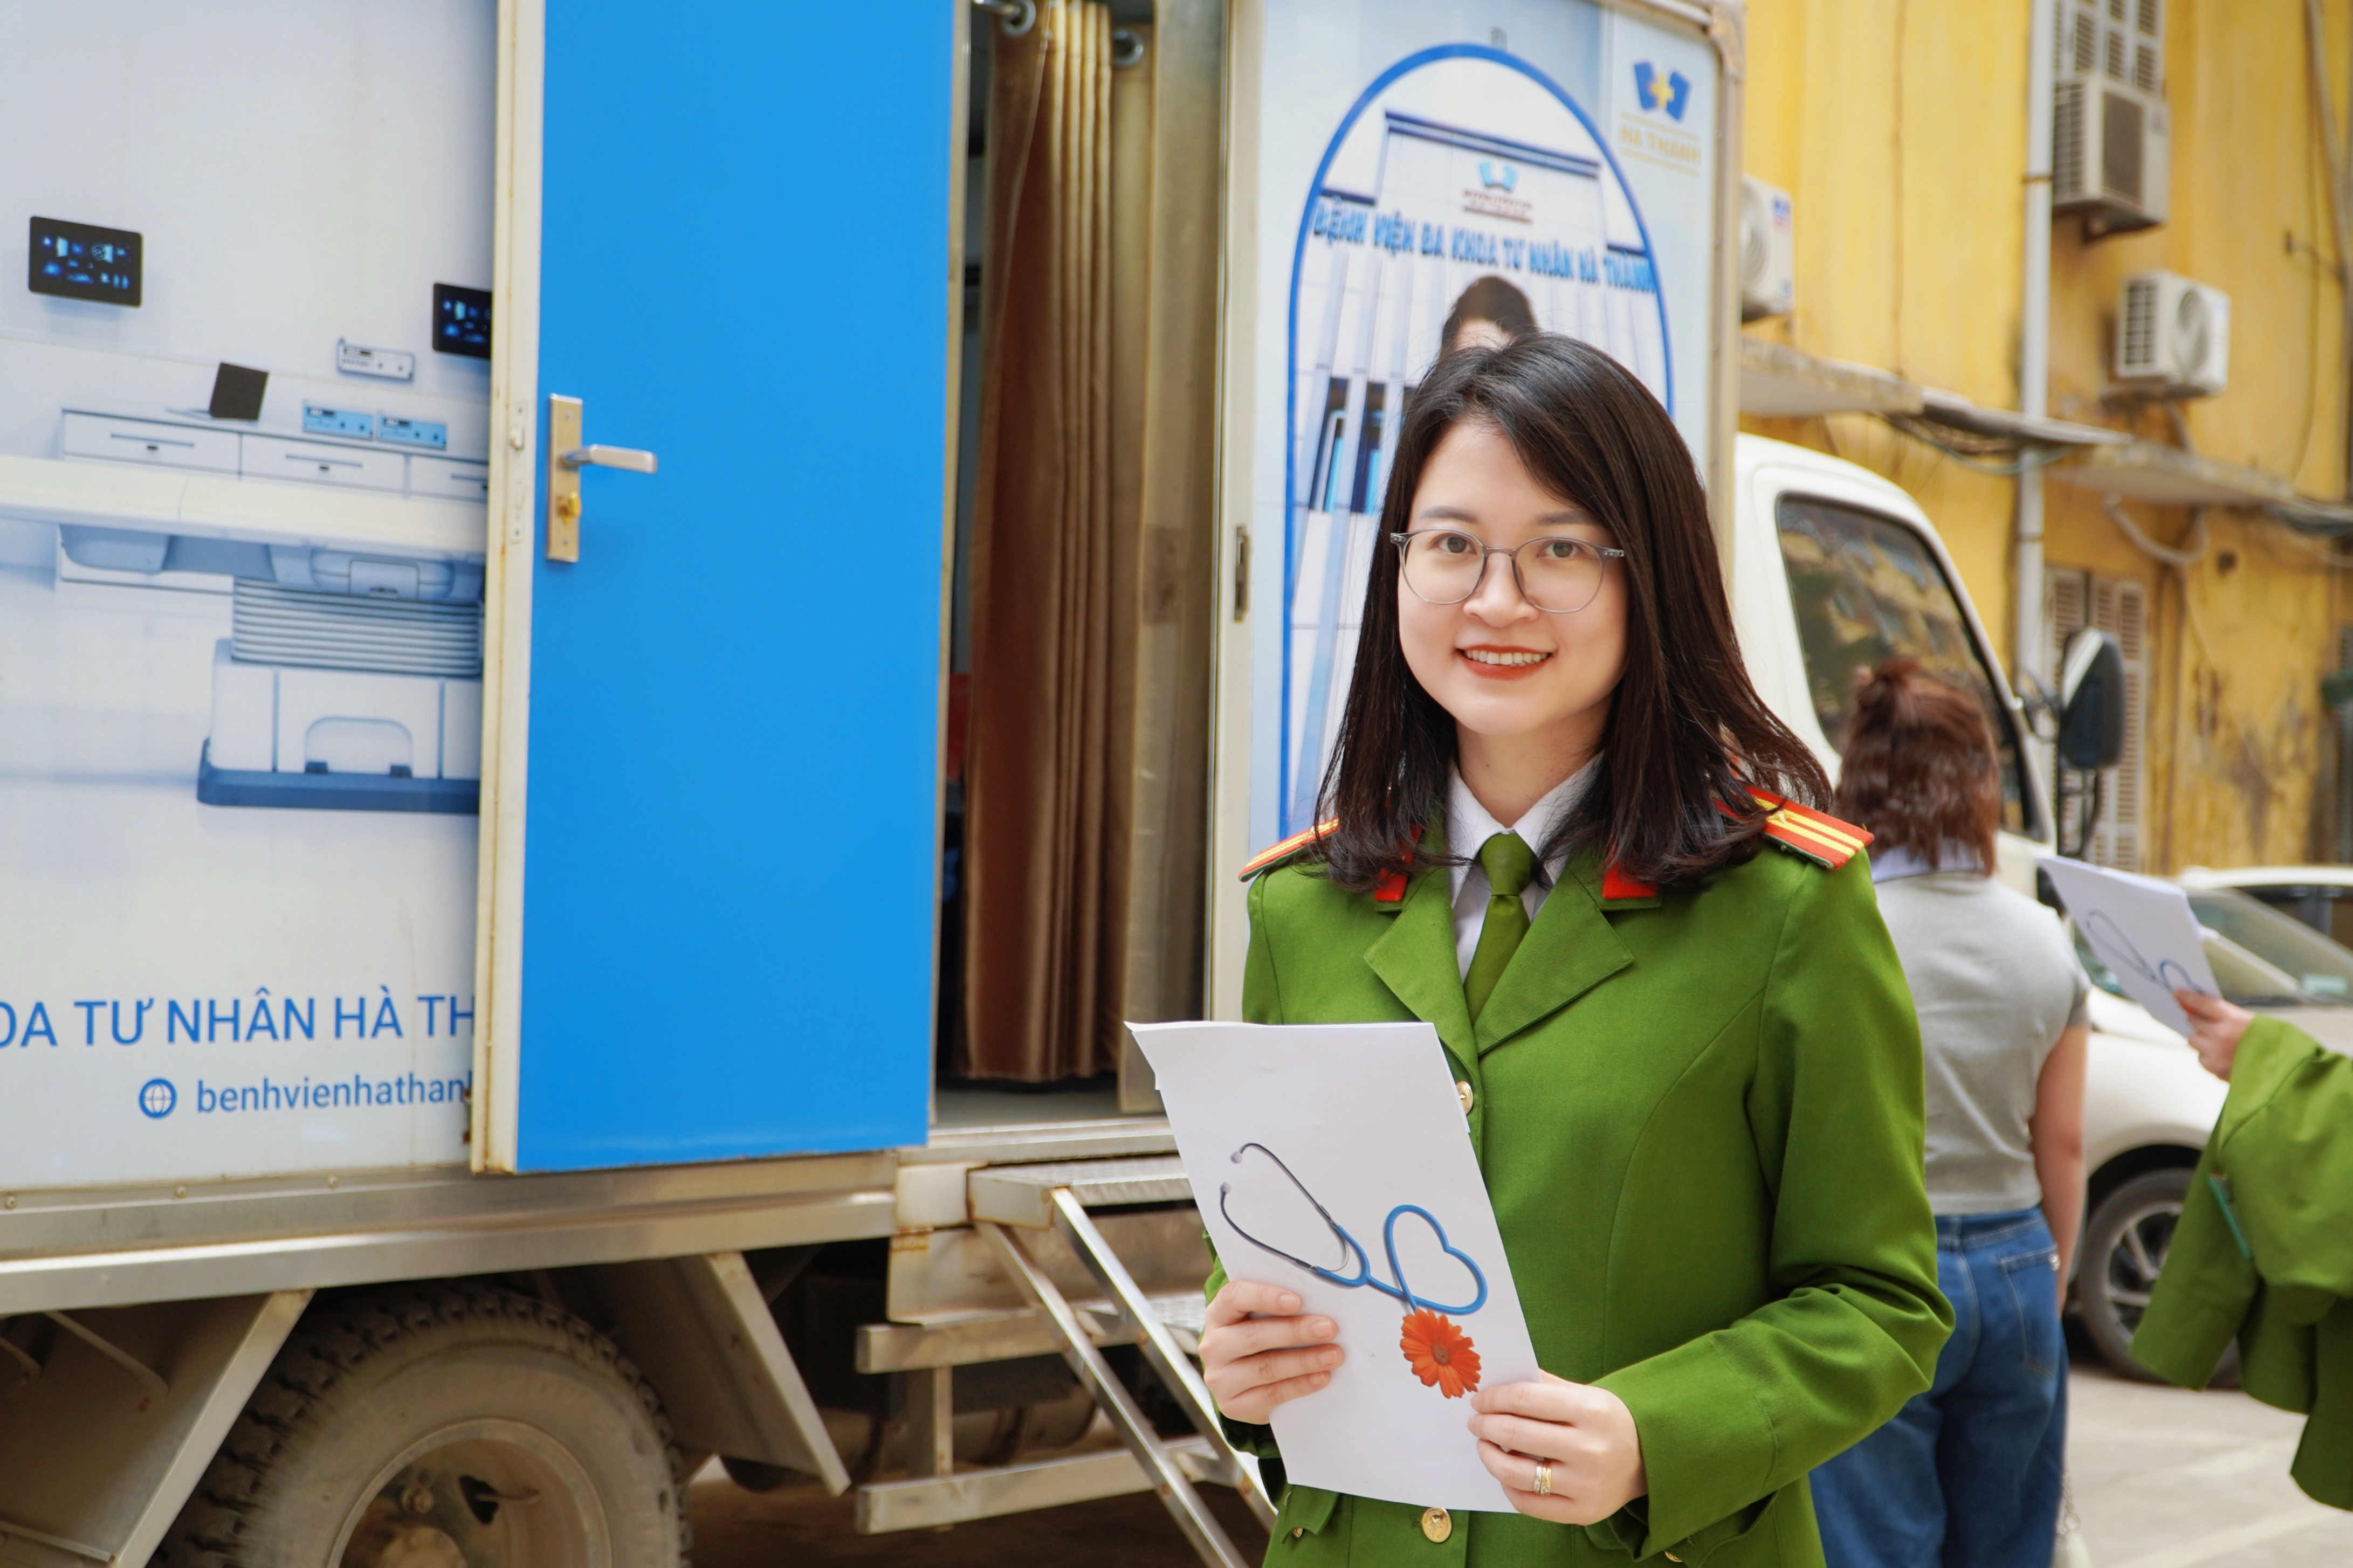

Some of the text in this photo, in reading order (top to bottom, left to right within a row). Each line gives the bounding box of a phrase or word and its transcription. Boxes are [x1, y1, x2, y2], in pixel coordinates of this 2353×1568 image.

[1452, 226, 1498, 266] KHOA
[73, 998, 155, 1047] TƯ
[168, 986, 316, 1044] NHÂN
[334, 984, 403, 1039] HÀ
